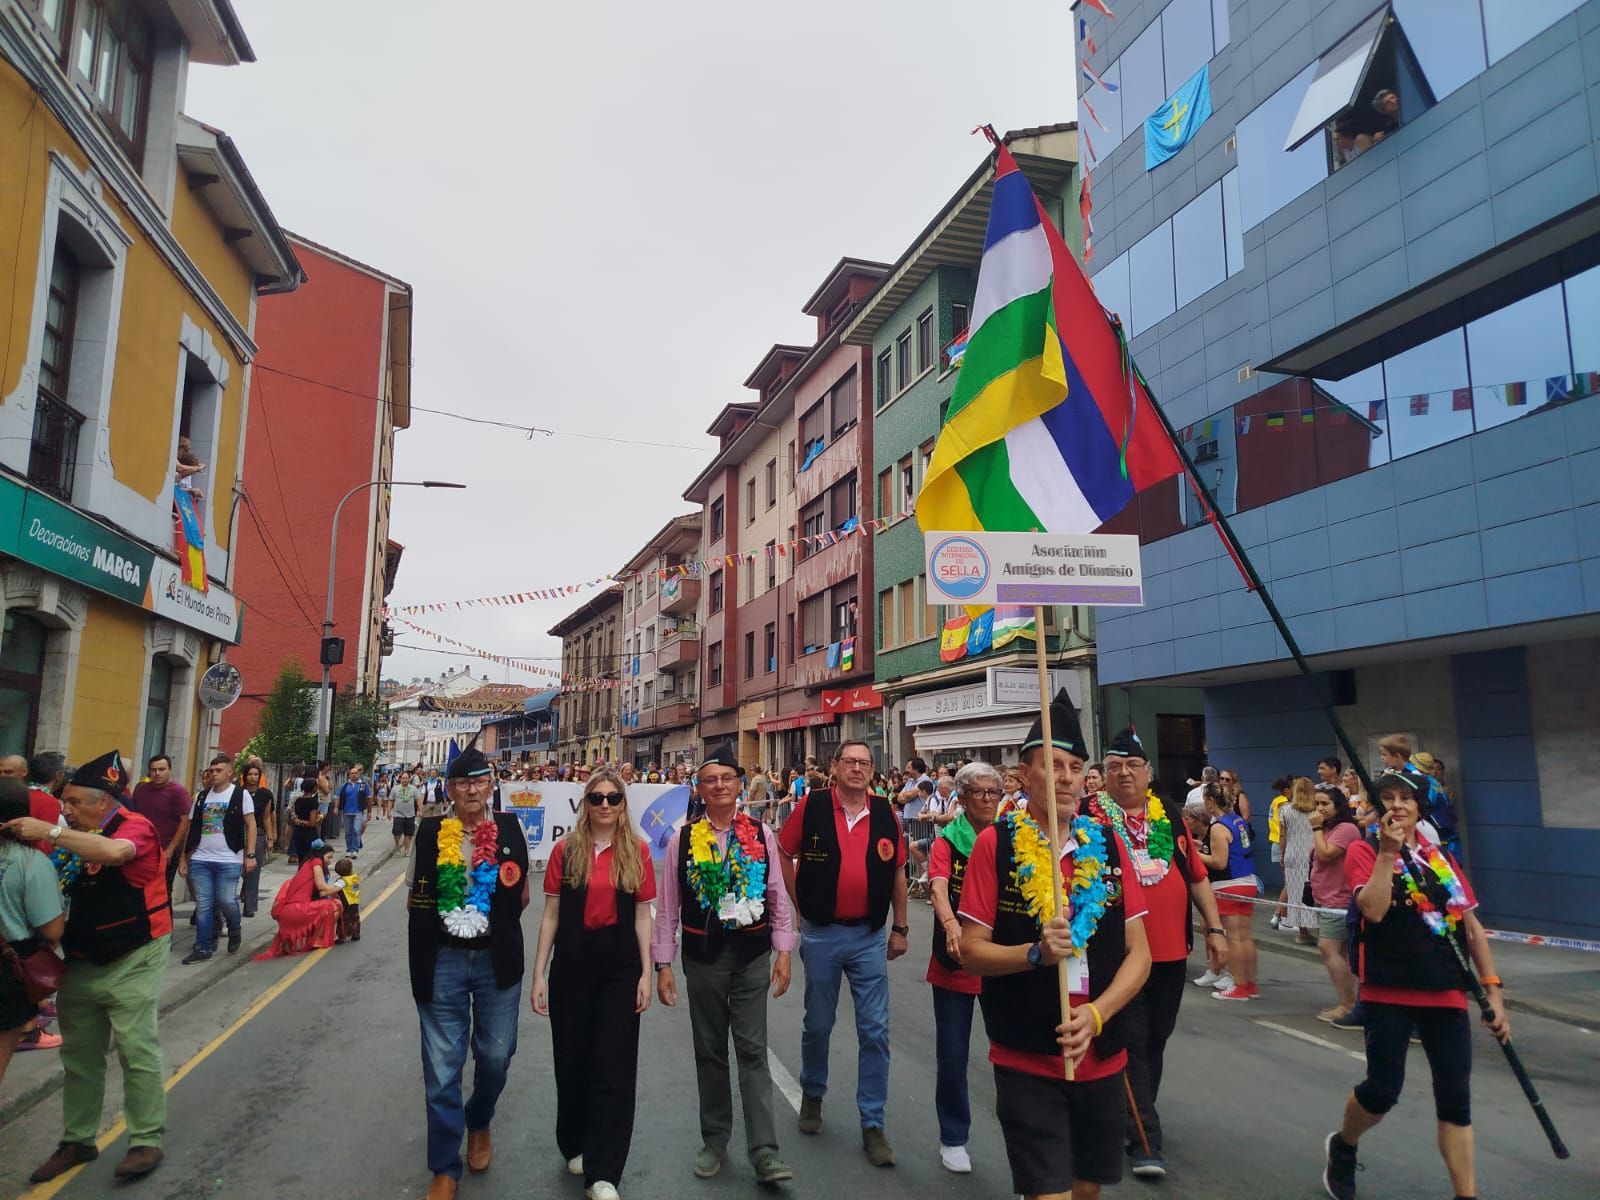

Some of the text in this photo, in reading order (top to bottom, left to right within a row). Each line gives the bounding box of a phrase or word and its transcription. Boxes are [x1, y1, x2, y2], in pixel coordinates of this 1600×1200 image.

[29, 518, 140, 587] Decoraciones MARGA
[940, 565, 981, 577] SELLA
[1002, 562, 1055, 579] Amigos
[1058, 563, 1075, 577] de
[176, 589, 184, 605] El
[184, 591, 205, 615] Mundo
[205, 604, 215, 619] del
[935, 696, 959, 714] SAN
